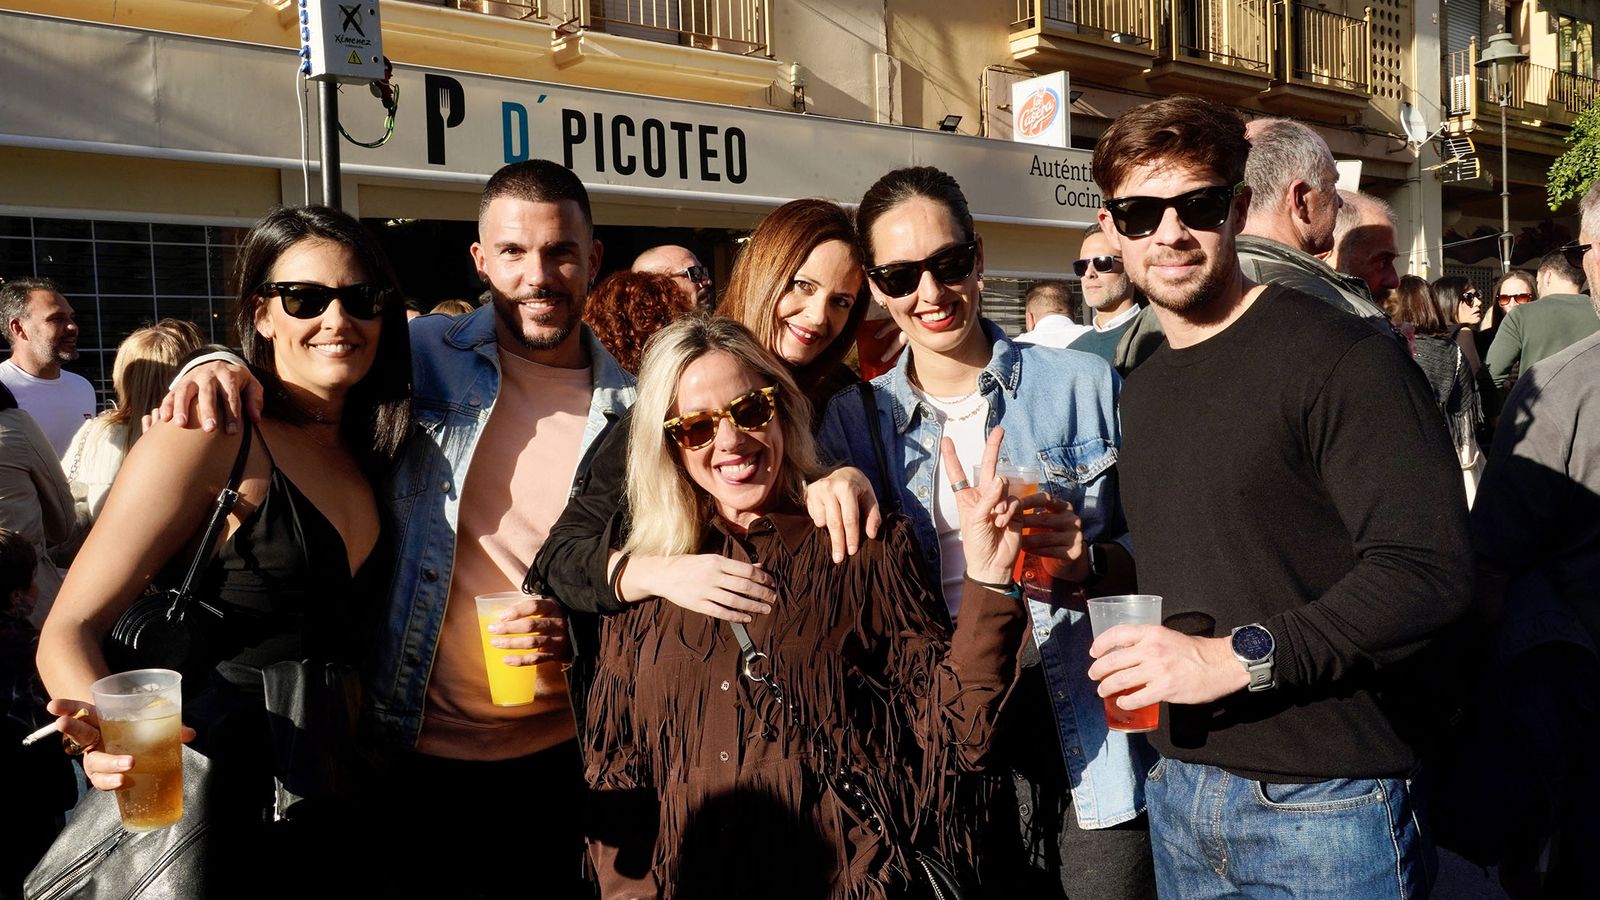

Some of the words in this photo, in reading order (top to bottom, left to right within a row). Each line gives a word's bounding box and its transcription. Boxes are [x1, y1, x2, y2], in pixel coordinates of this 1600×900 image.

[334, 34, 372, 46] Ximenez
[562, 108, 748, 184] PICOTEO
[1029, 154, 1094, 182] Auténti
[1055, 185, 1102, 209] Cocin
